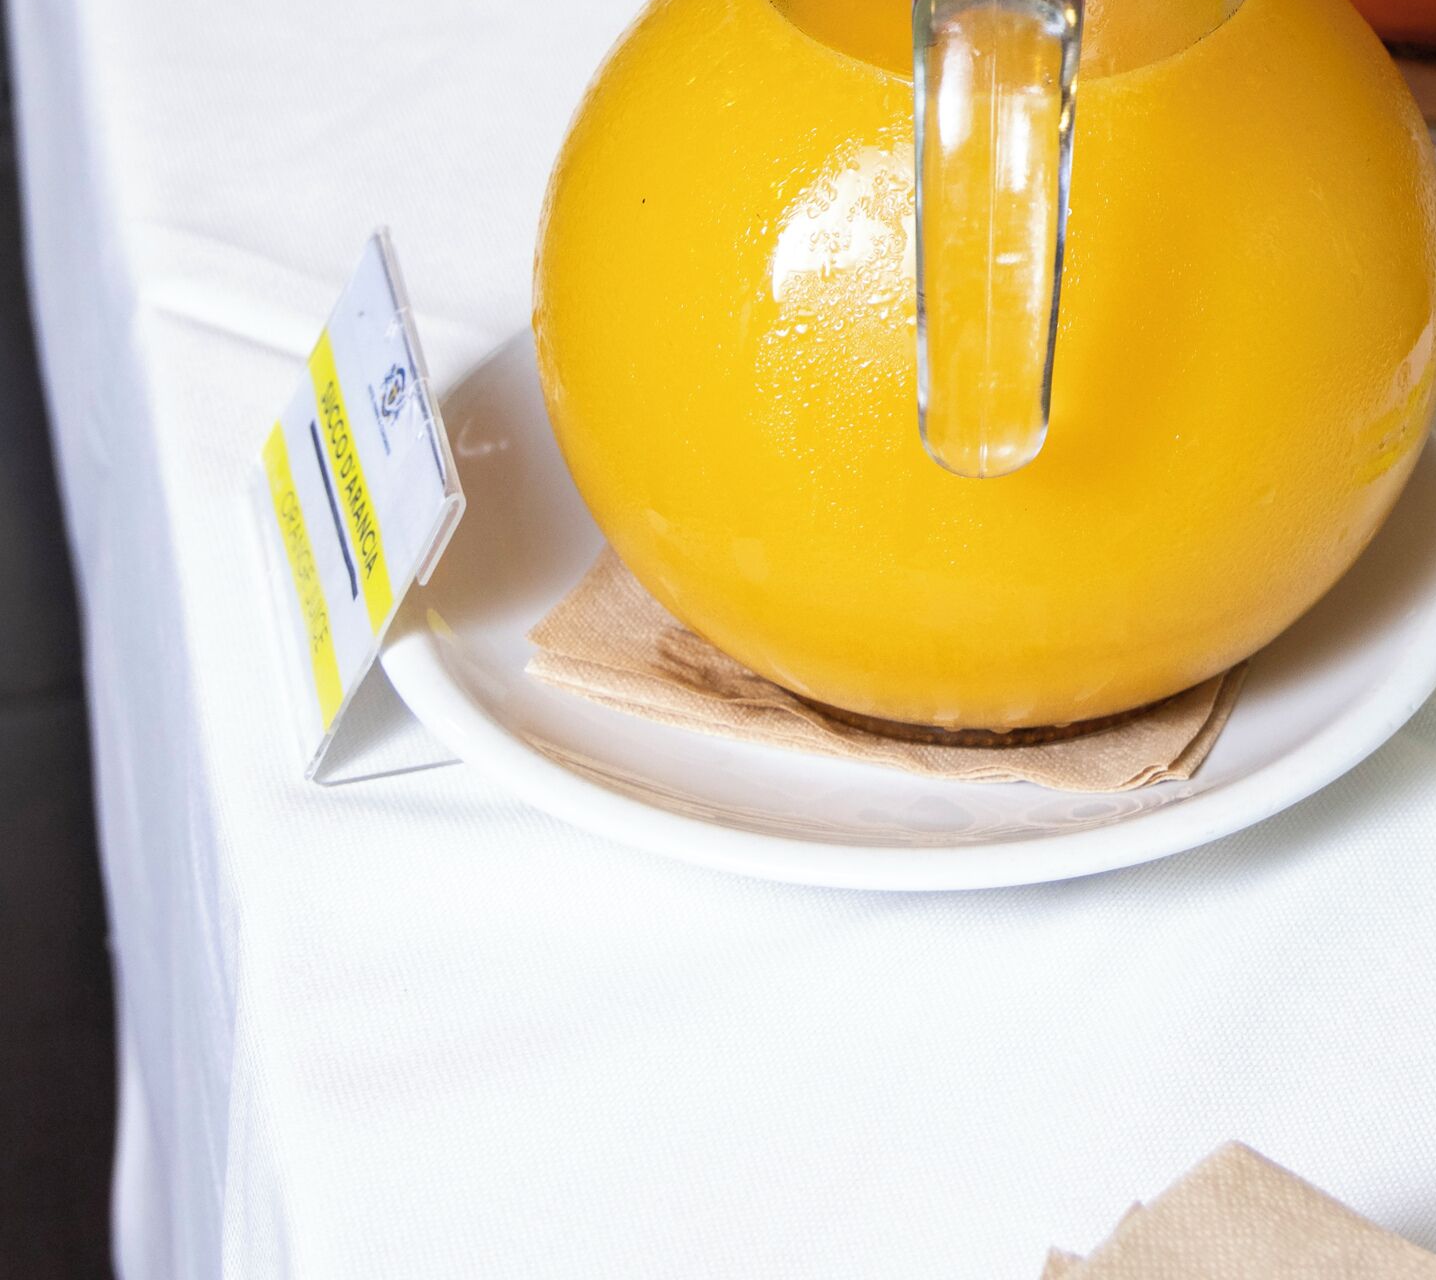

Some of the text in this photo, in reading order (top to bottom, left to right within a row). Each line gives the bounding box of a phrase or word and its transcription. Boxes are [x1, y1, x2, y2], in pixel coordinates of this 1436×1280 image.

[320, 380, 348, 460] SUCCO
[340, 453, 379, 580] D'ARANCIA
[280, 490, 330, 653] ORANGE JUICE
